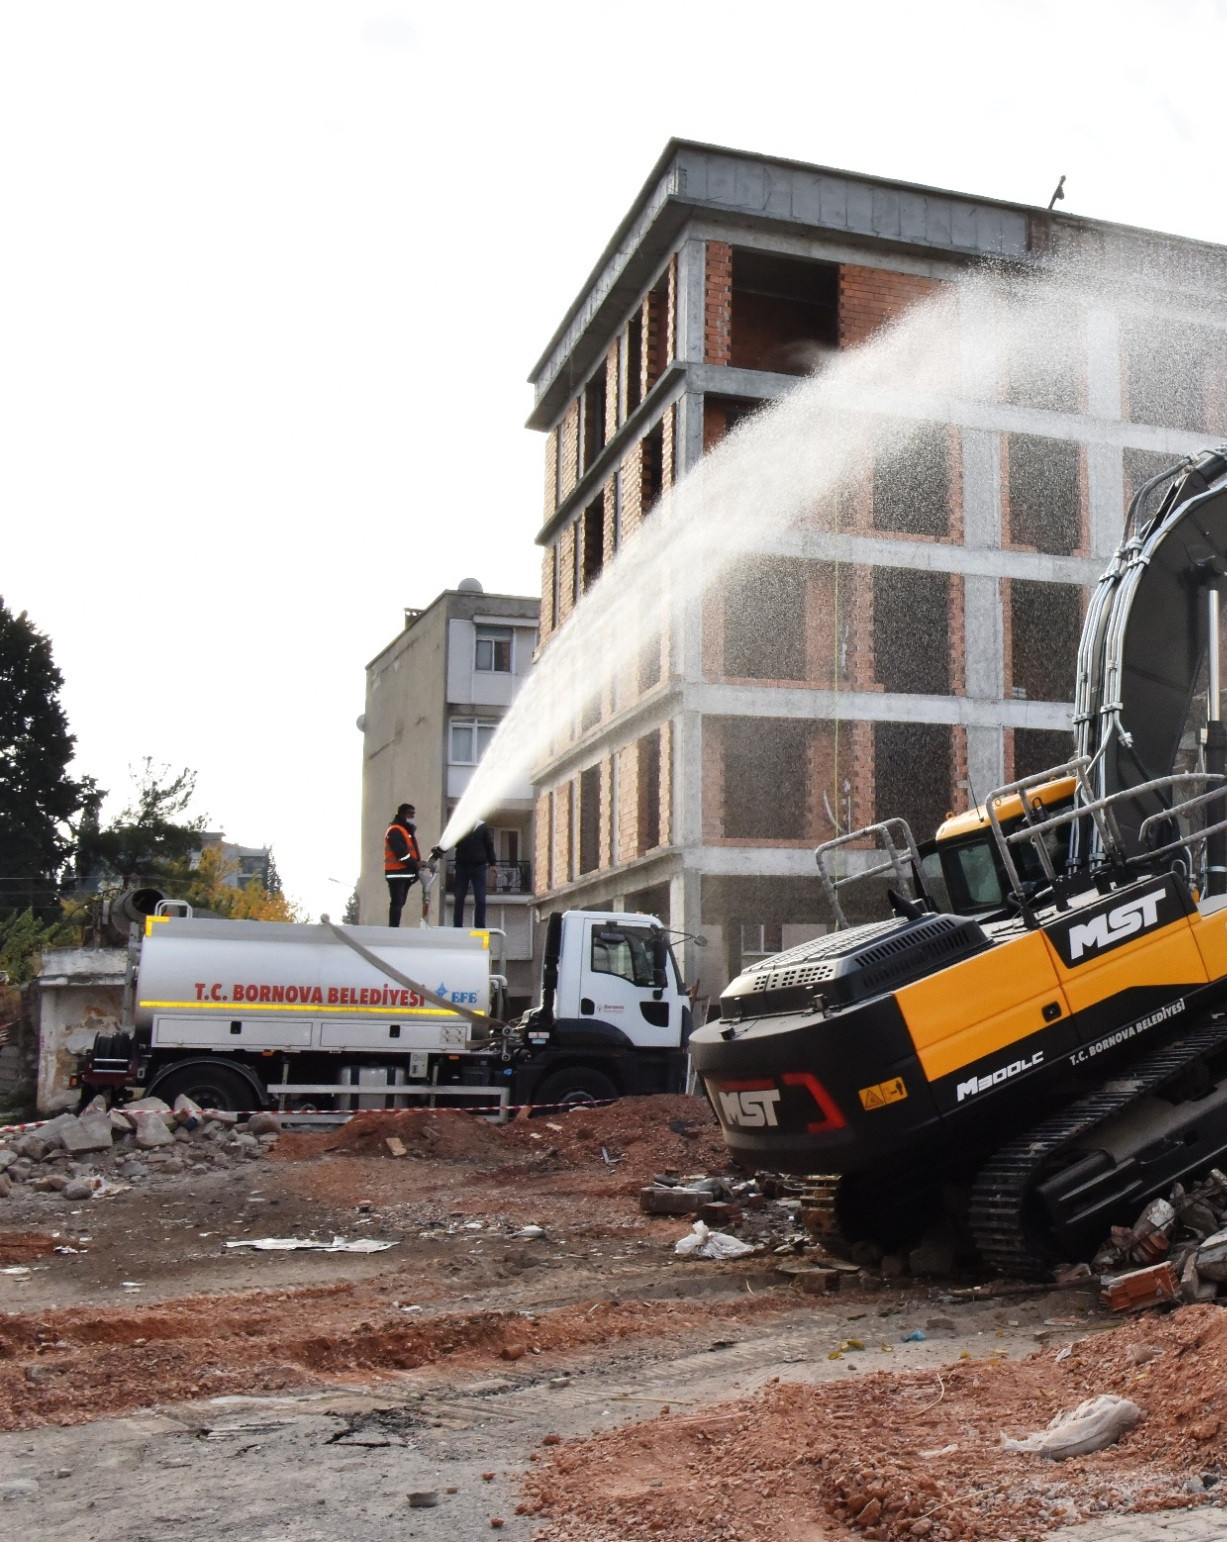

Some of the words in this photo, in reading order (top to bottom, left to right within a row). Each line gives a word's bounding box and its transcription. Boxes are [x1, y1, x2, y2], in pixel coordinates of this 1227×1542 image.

[1068, 887, 1167, 960] MST
[194, 982, 228, 1001] T.C.
[233, 984, 324, 1004] BORNOVA
[327, 983, 427, 1007] BELEDİYESİ
[451, 991, 479, 1004] EFE
[1069, 1050, 1089, 1066] T.C.
[1088, 1026, 1137, 1057] BORNOVA
[1135, 997, 1186, 1033] BELEDİYESİ
[956, 1050, 1045, 1102] M300LC
[718, 1088, 781, 1127] MST
